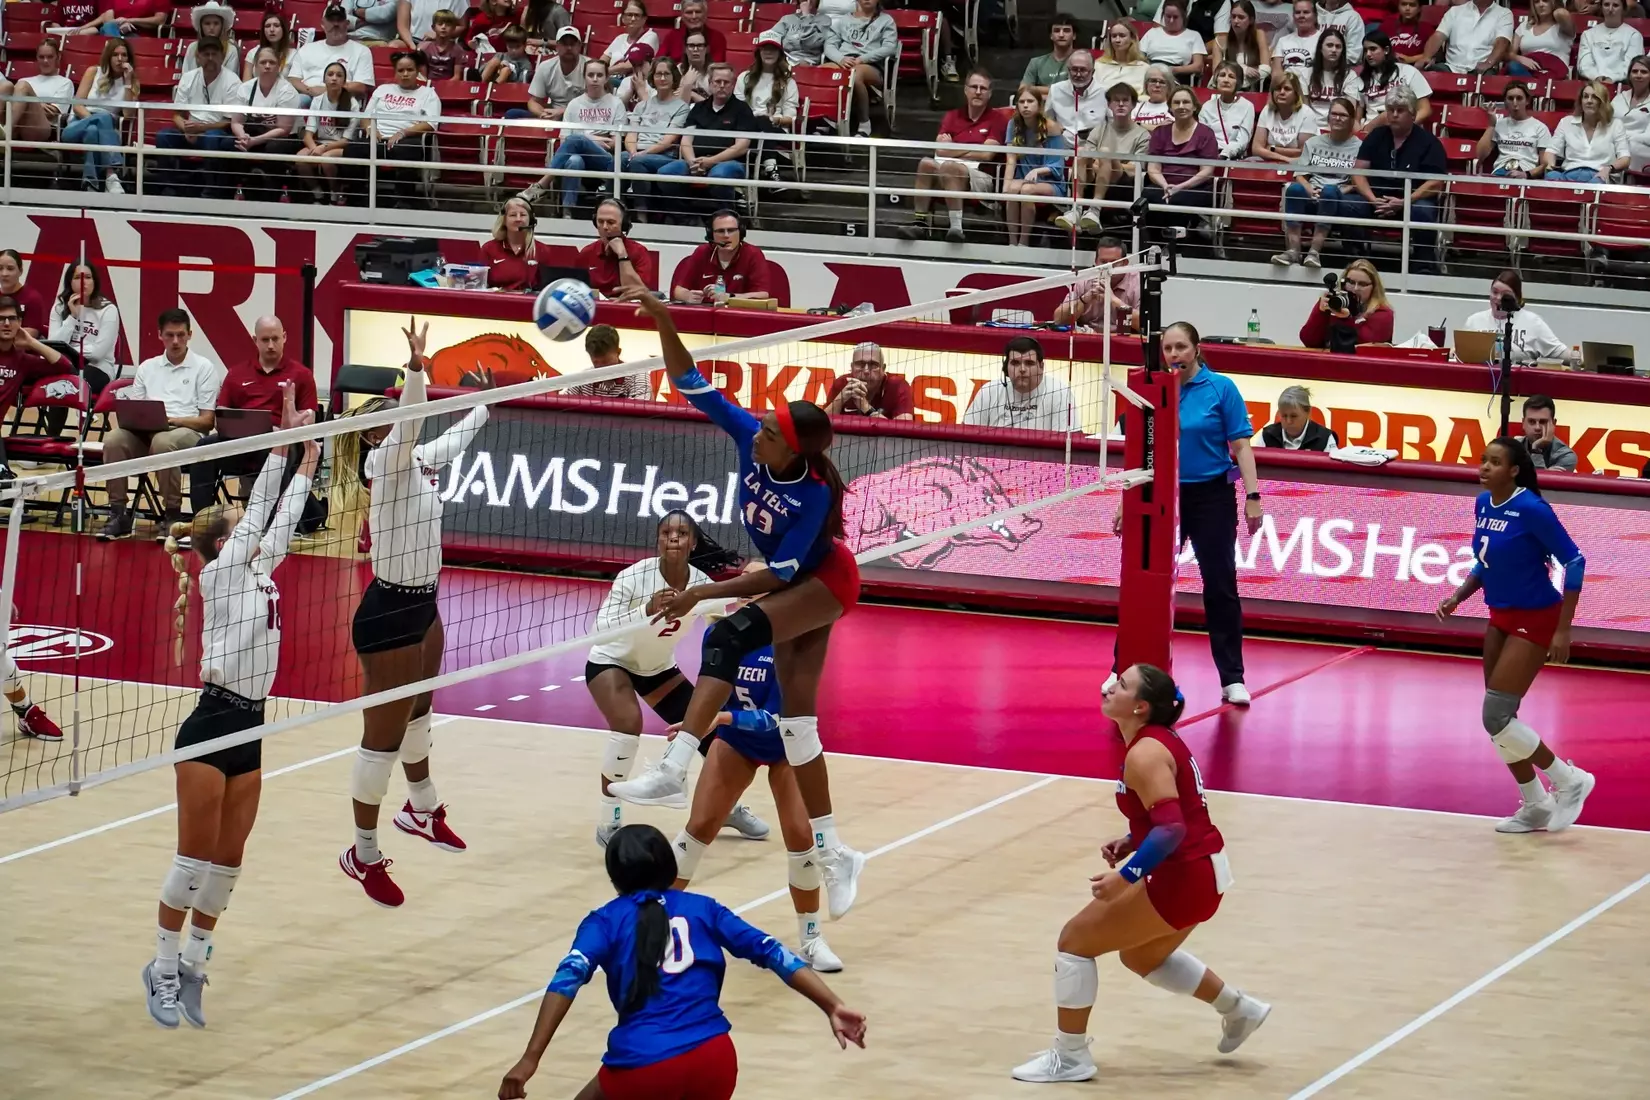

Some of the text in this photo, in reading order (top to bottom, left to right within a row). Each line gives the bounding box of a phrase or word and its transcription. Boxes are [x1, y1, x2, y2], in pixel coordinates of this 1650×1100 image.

[846, 224, 856, 236] 5
[604, 462, 747, 527] Heal
[744, 472, 761, 495] LA
[746, 501, 773, 535] 13
[1477, 517, 1509, 532] LA TECH
[737, 666, 767, 682] TECH
[735, 685, 757, 712] 5
[656, 916, 695, 974] 0
